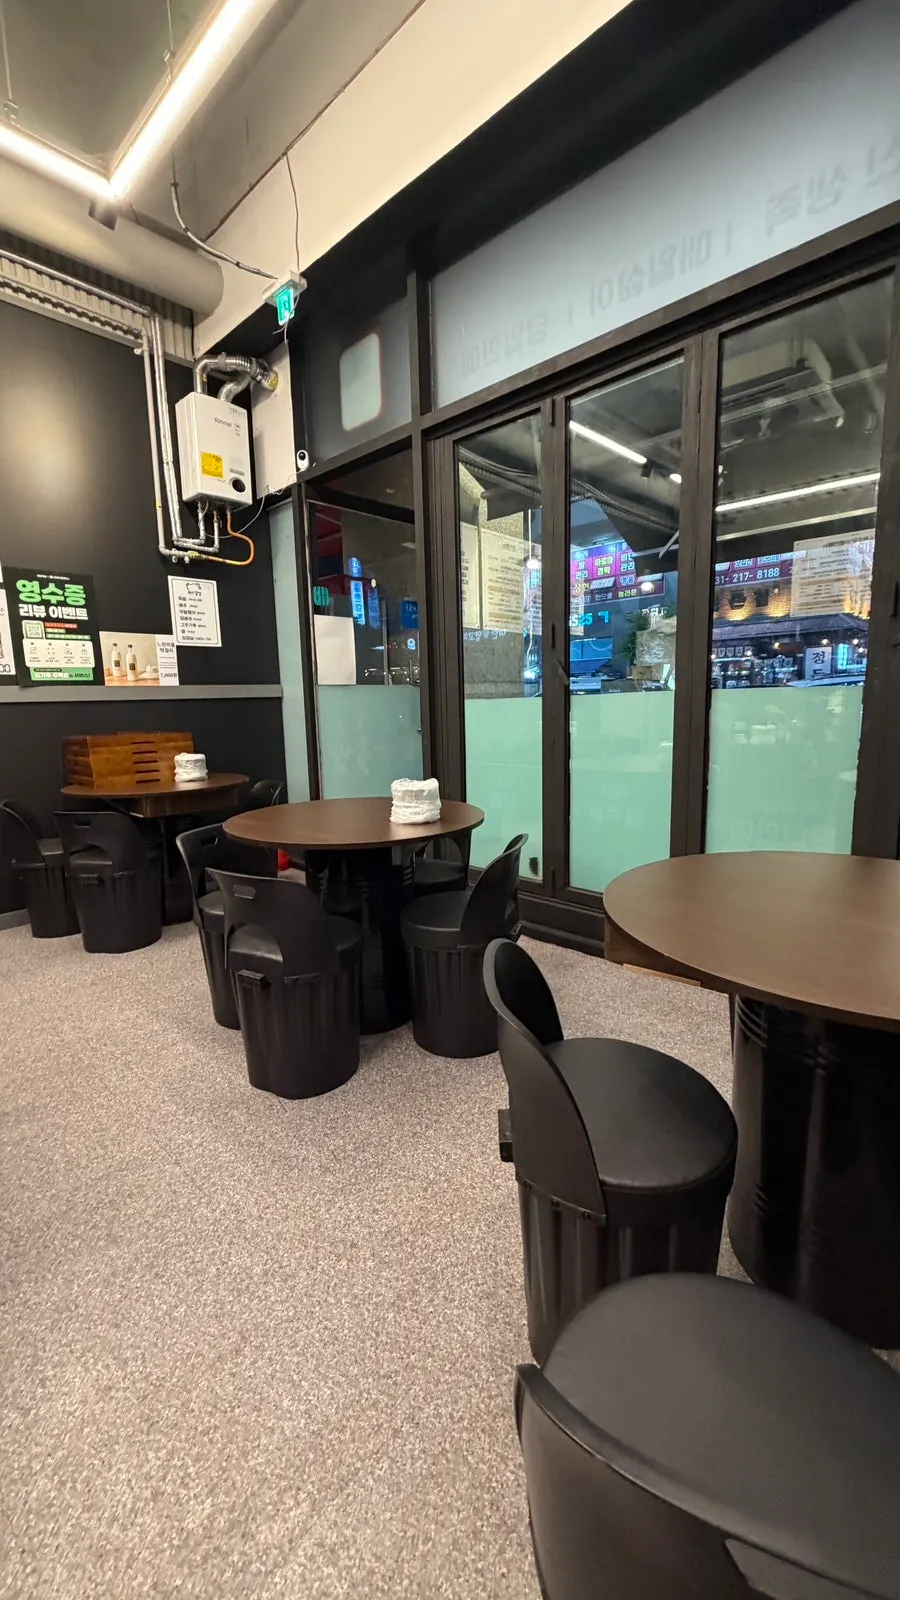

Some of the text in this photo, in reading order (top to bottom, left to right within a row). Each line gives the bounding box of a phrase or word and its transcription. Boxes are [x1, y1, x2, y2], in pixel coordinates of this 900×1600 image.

[715, 567, 780, 585] 31- 217- 8188
[16, 579, 86, 605] 영수증
[18, 603, 47, 618] 리뷰
[48, 605, 89, 621] 이벤트
